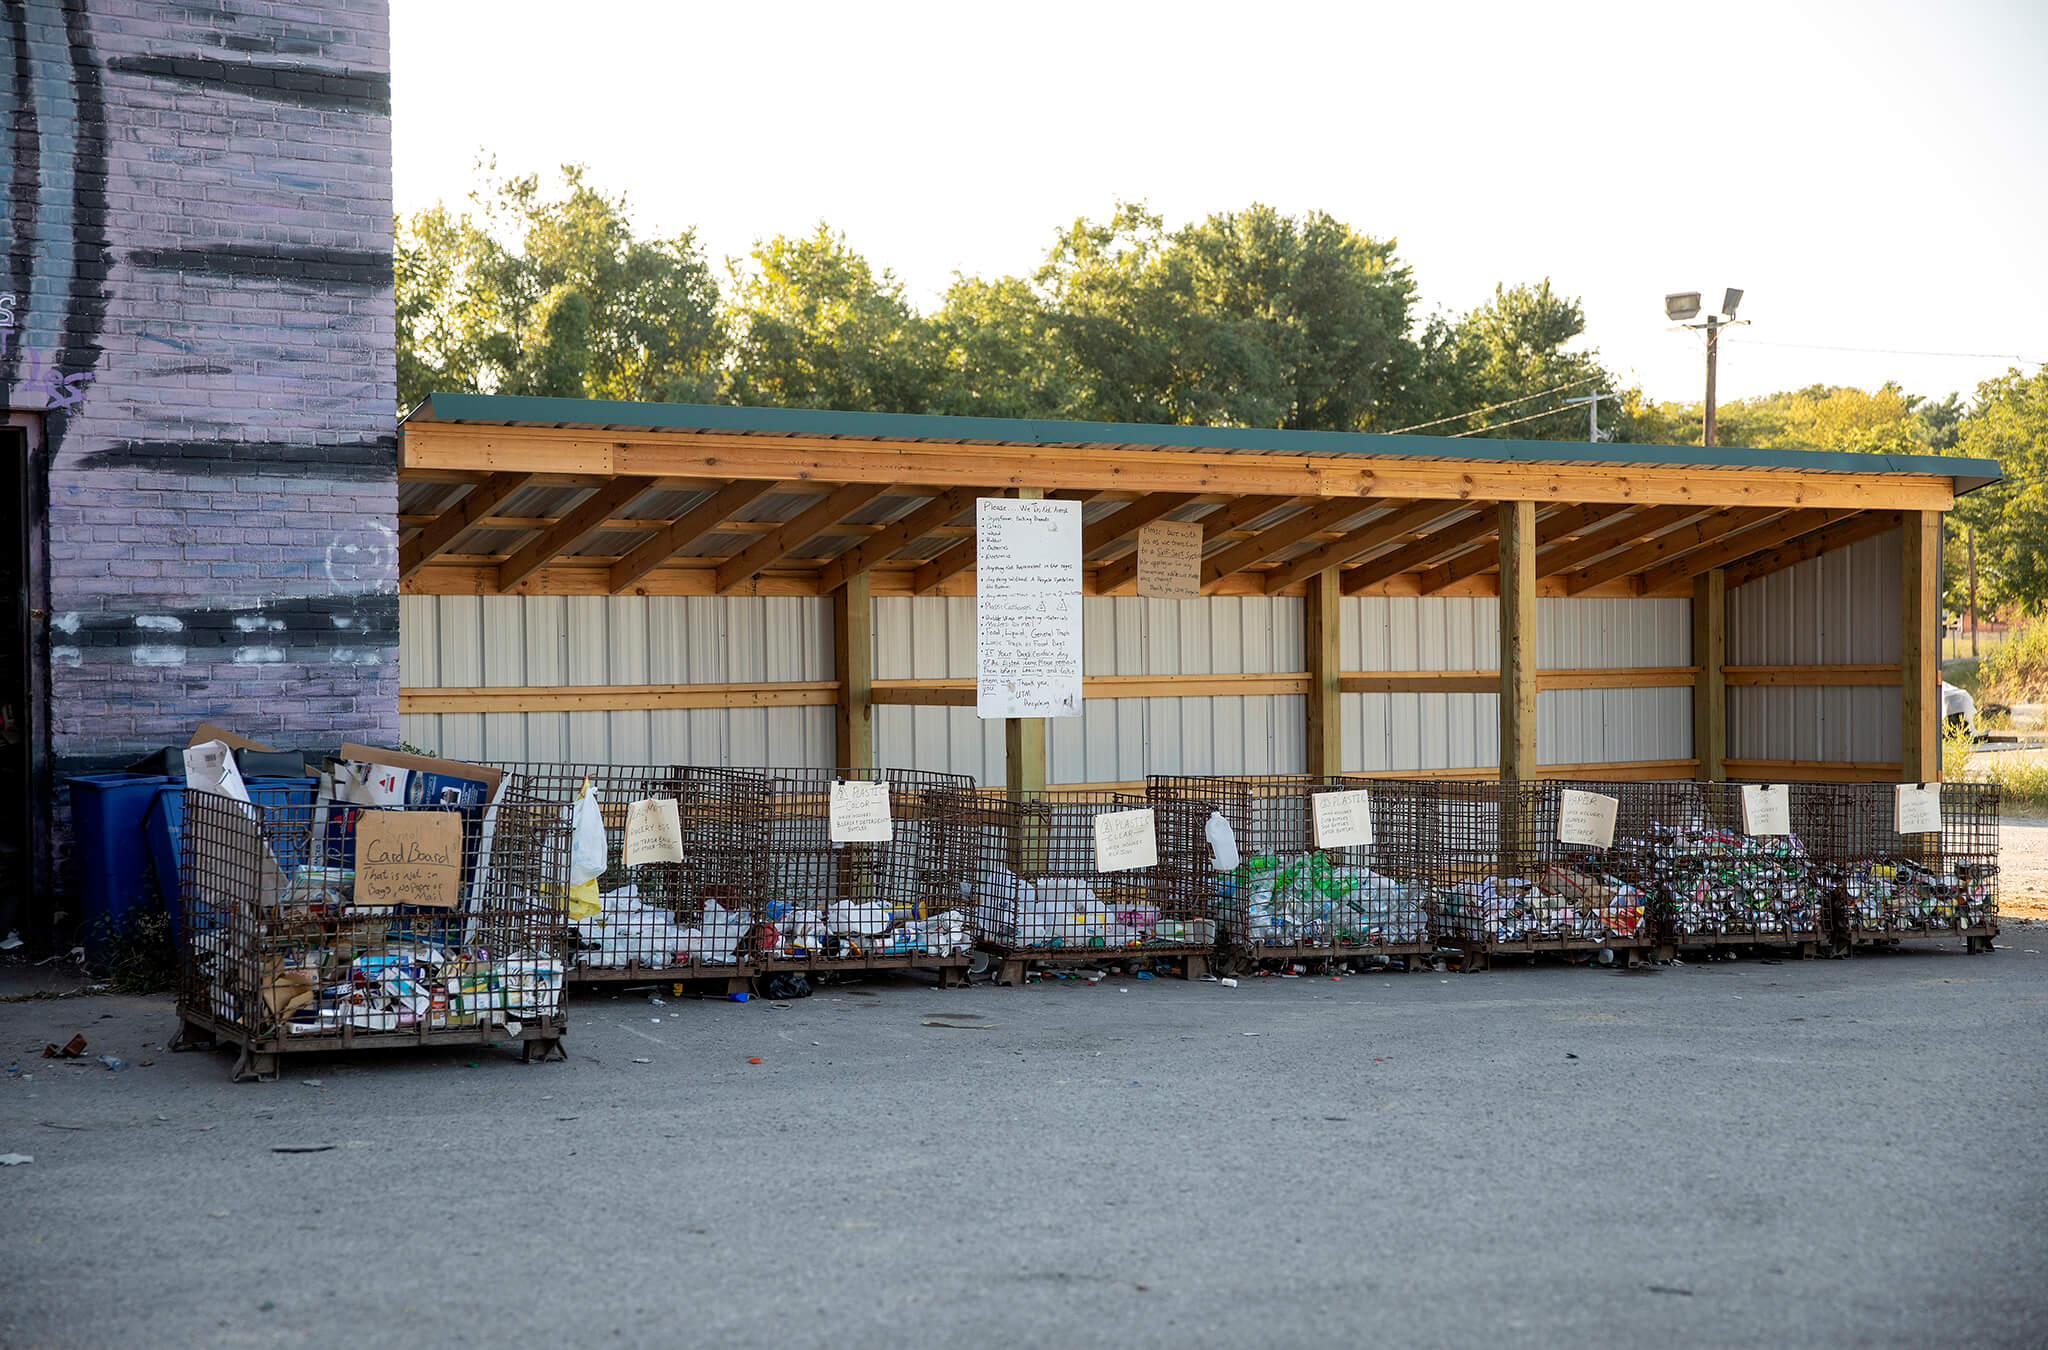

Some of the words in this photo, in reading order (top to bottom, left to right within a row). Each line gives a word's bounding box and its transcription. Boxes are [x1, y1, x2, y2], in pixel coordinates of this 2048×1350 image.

[846, 800, 871, 811] COLOR
[1107, 830, 1134, 841] CLEAR
[363, 866, 388, 881] That
[391, 870, 399, 881] is
